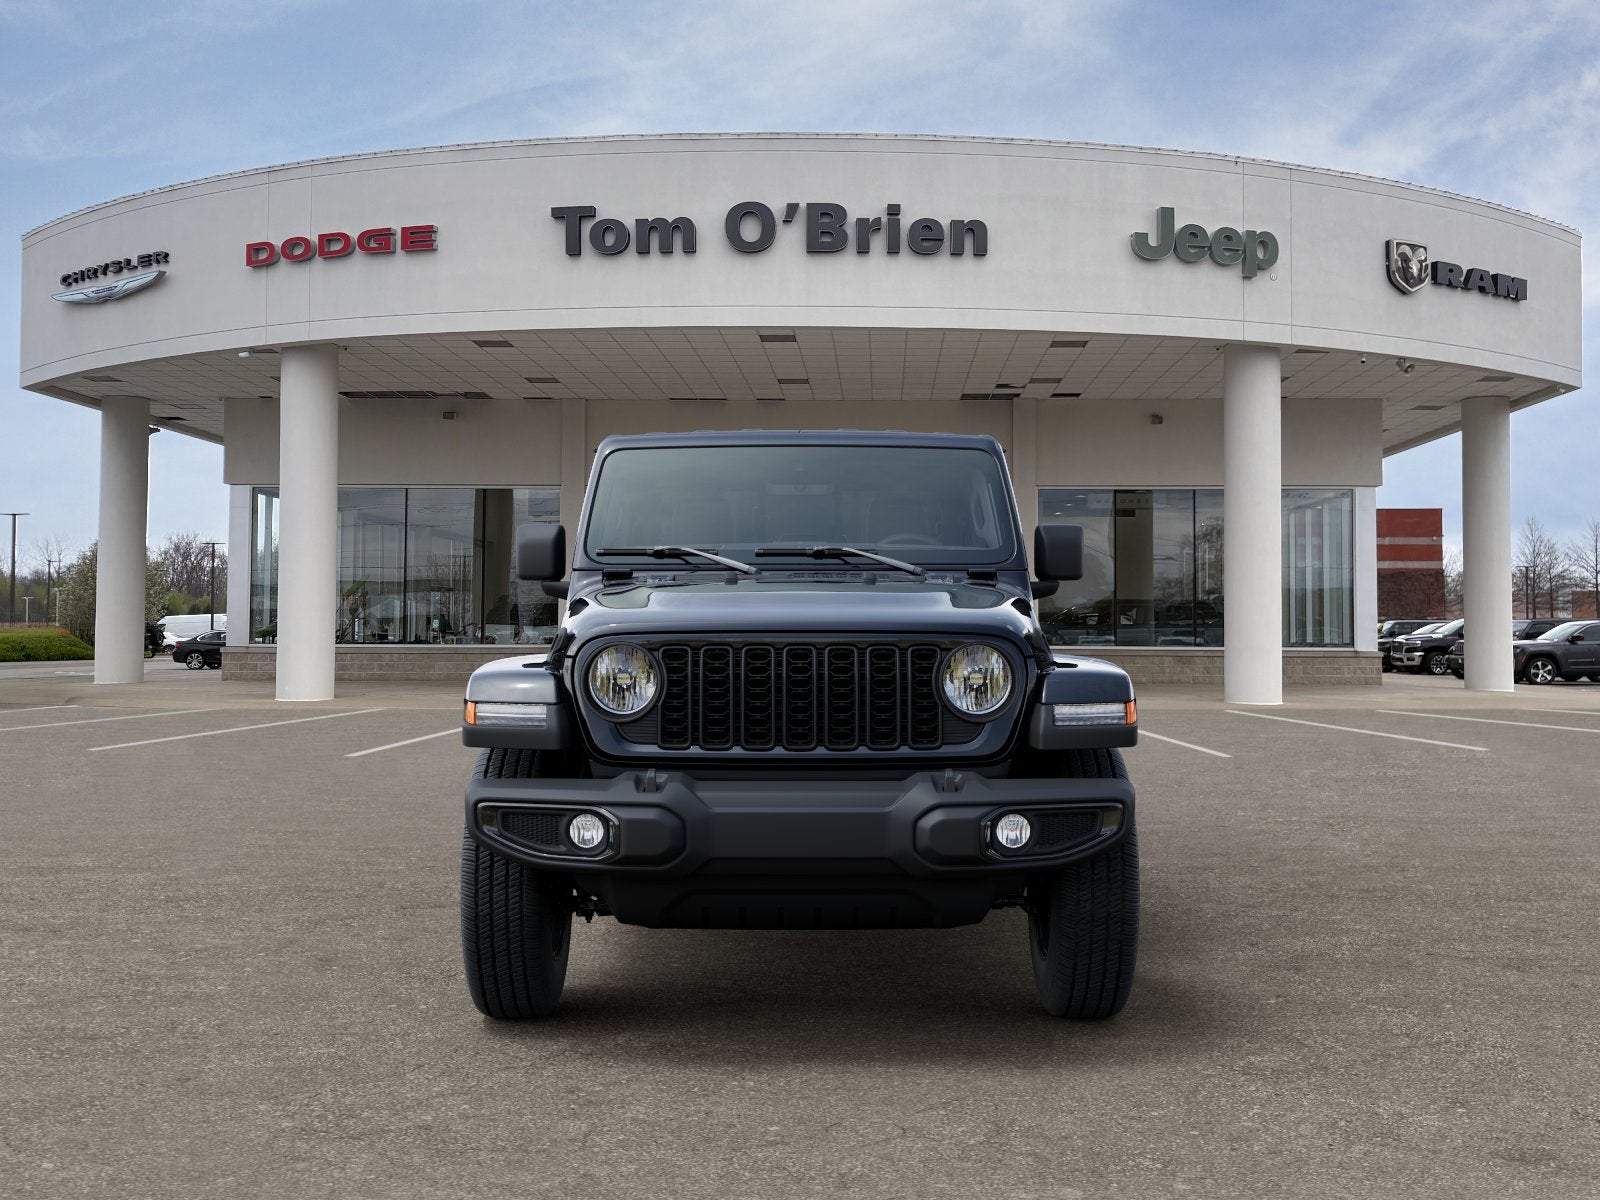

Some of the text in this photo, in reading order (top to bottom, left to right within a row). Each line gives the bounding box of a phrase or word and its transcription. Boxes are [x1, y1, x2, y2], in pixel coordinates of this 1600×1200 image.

[245, 224, 438, 268] DODGE
[551, 200, 989, 257] Tom O'Brien
[1130, 206, 1279, 279] Jeep
[59, 250, 170, 287] CHRYSLER
[1431, 260, 1528, 302] RAM
